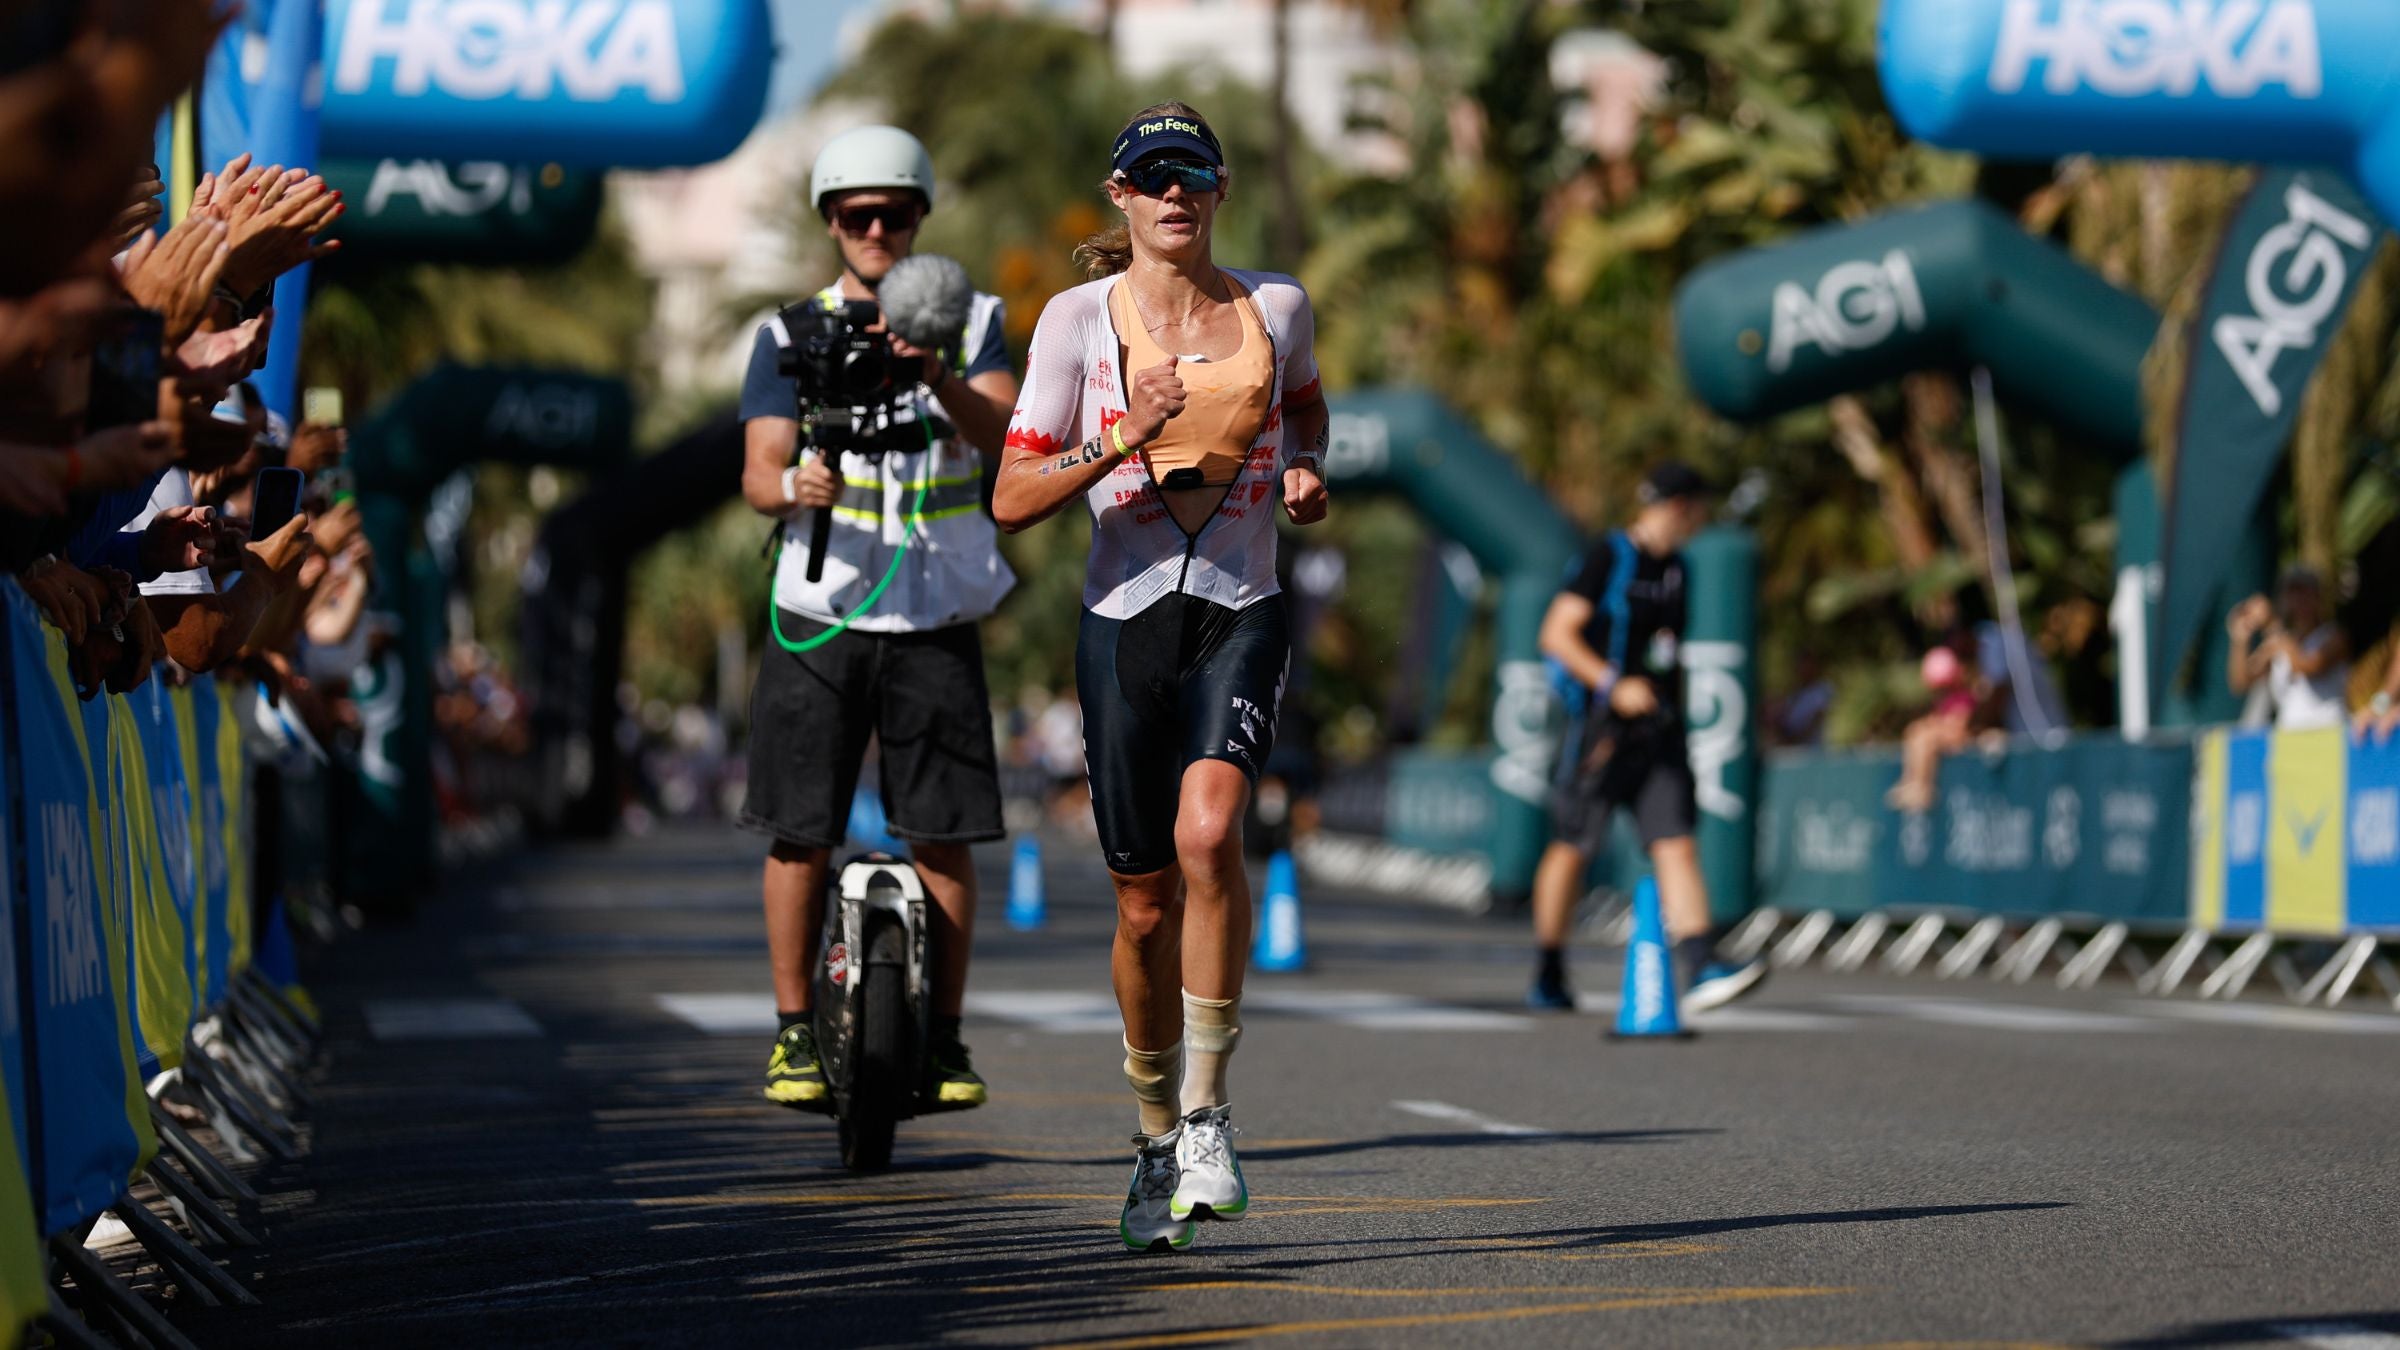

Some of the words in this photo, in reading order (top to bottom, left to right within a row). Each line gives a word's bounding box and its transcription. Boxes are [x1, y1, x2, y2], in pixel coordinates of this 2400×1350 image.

[333, 0, 688, 102] HOKA
[1987, 0, 2323, 98] HOKA
[1138, 121, 1163, 137] The
[1165, 118, 1201, 138] Feed.
[1766, 248, 1927, 374] AGI
[2212, 181, 2371, 418] AGI
[1112, 467, 1147, 477] FACTORY
[1231, 696, 1266, 728] NYAC
